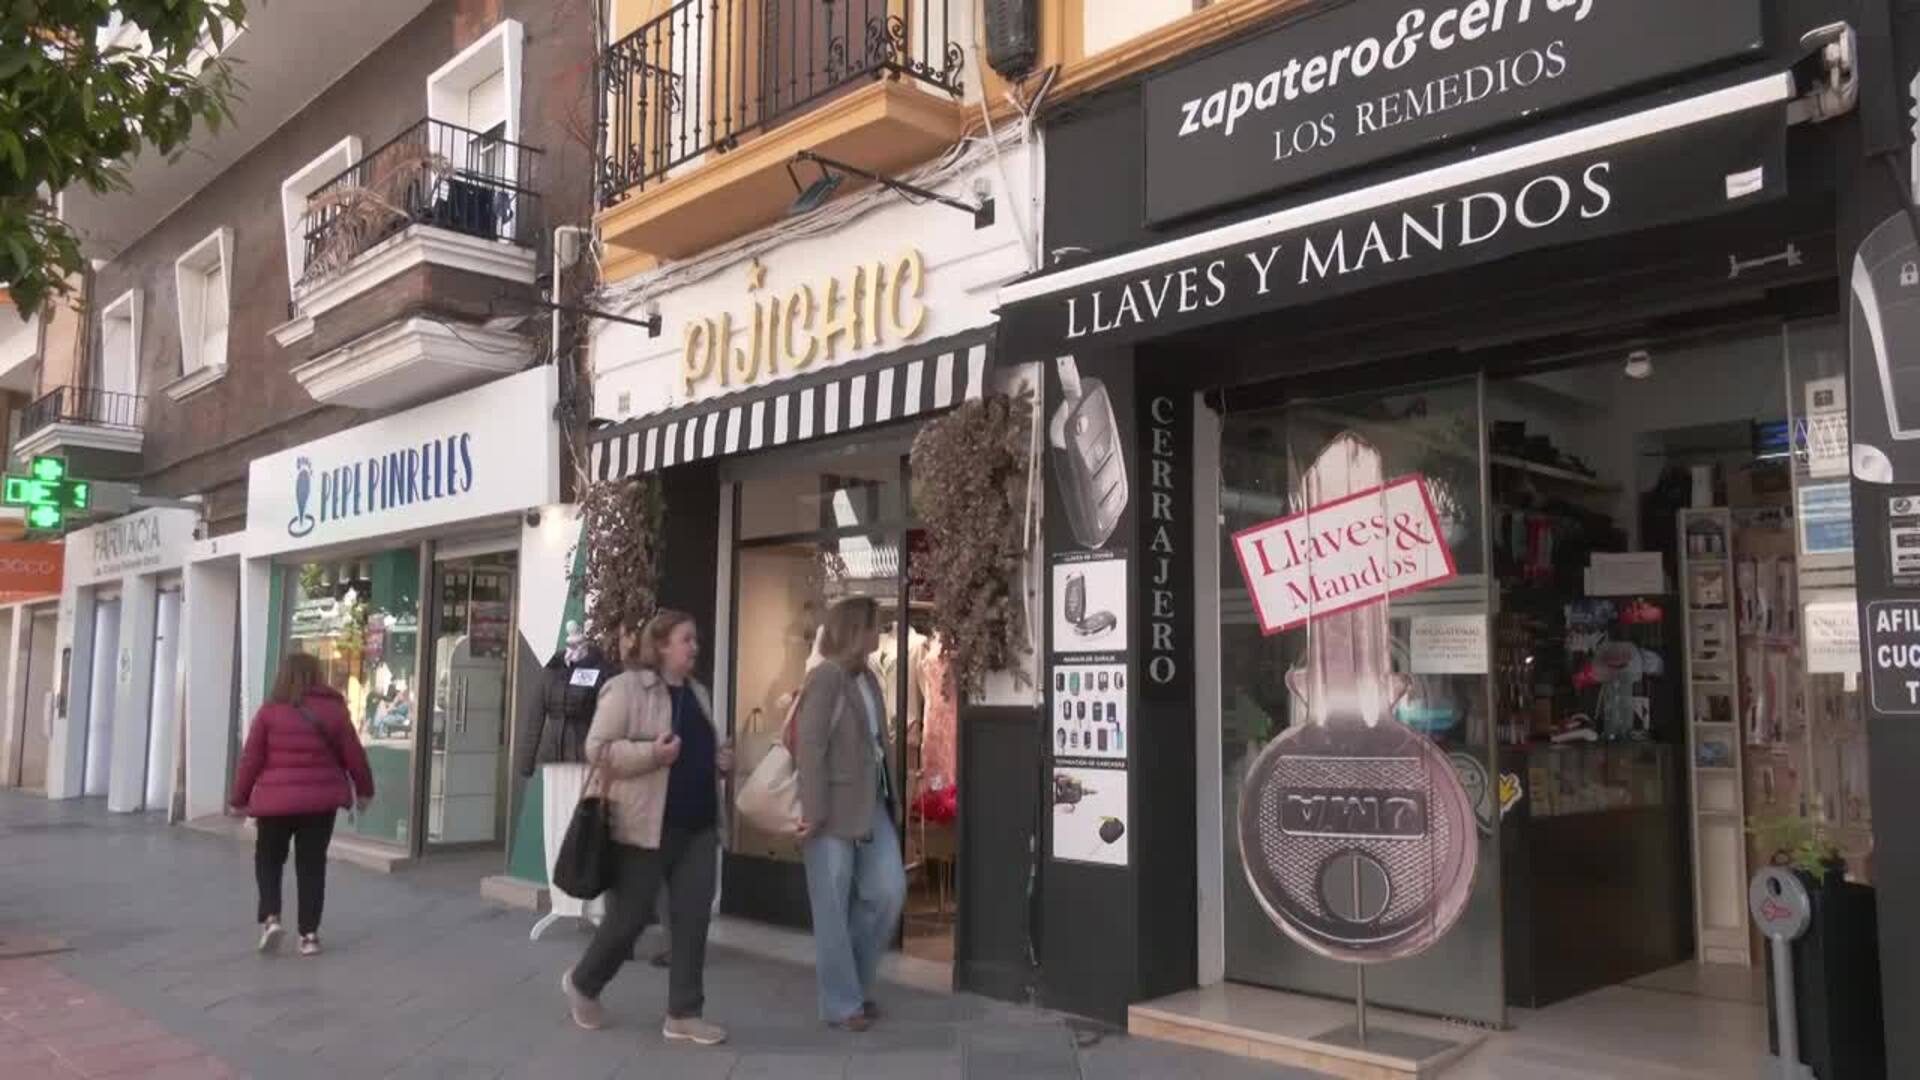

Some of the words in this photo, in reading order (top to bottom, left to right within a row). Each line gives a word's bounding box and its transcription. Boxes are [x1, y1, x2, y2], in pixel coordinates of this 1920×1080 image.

[1273, 113, 1336, 161] LOS
[1355, 40, 1567, 136] REMEDIOS
[1066, 260, 1226, 338] LLAVES
[1246, 245, 1282, 295] Y
[1297, 162, 1612, 285] MANDOS
[684, 249, 928, 397] PIJICHIC
[95, 515, 161, 561] FARMACIA
[320, 462, 363, 523] PEPE
[367, 432, 473, 513] PINRELES
[1150, 396, 1176, 683] CERRAJERO
[1286, 555, 1418, 610] Mandos
